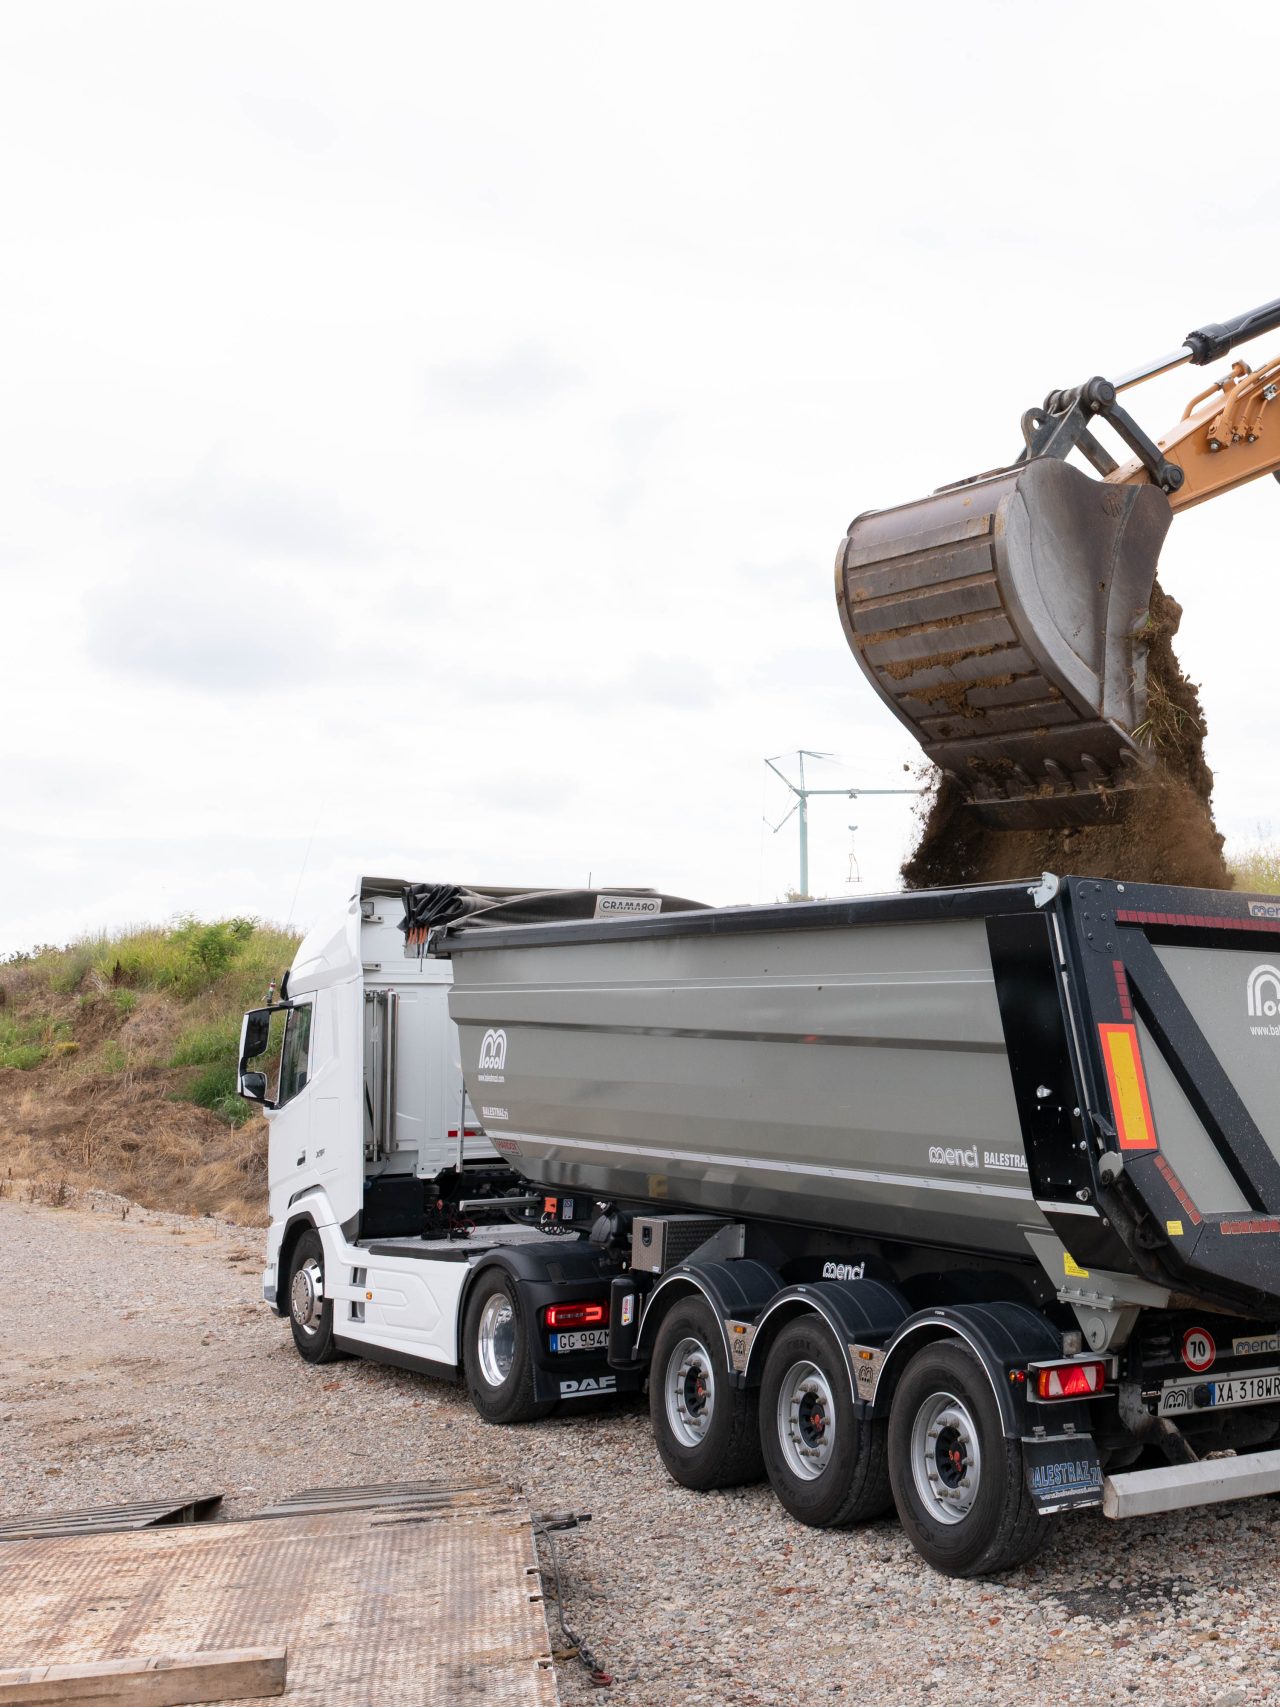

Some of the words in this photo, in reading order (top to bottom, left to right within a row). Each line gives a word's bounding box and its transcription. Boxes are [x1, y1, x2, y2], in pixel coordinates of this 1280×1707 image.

[602, 900, 655, 911] CRAMARO
[928, 1145, 979, 1168] menci
[822, 1261, 865, 1280] menci
[1190, 1340, 1206, 1359] 70
[1235, 1335, 1280, 1354] menci
[560, 1375, 616, 1393] DAF
